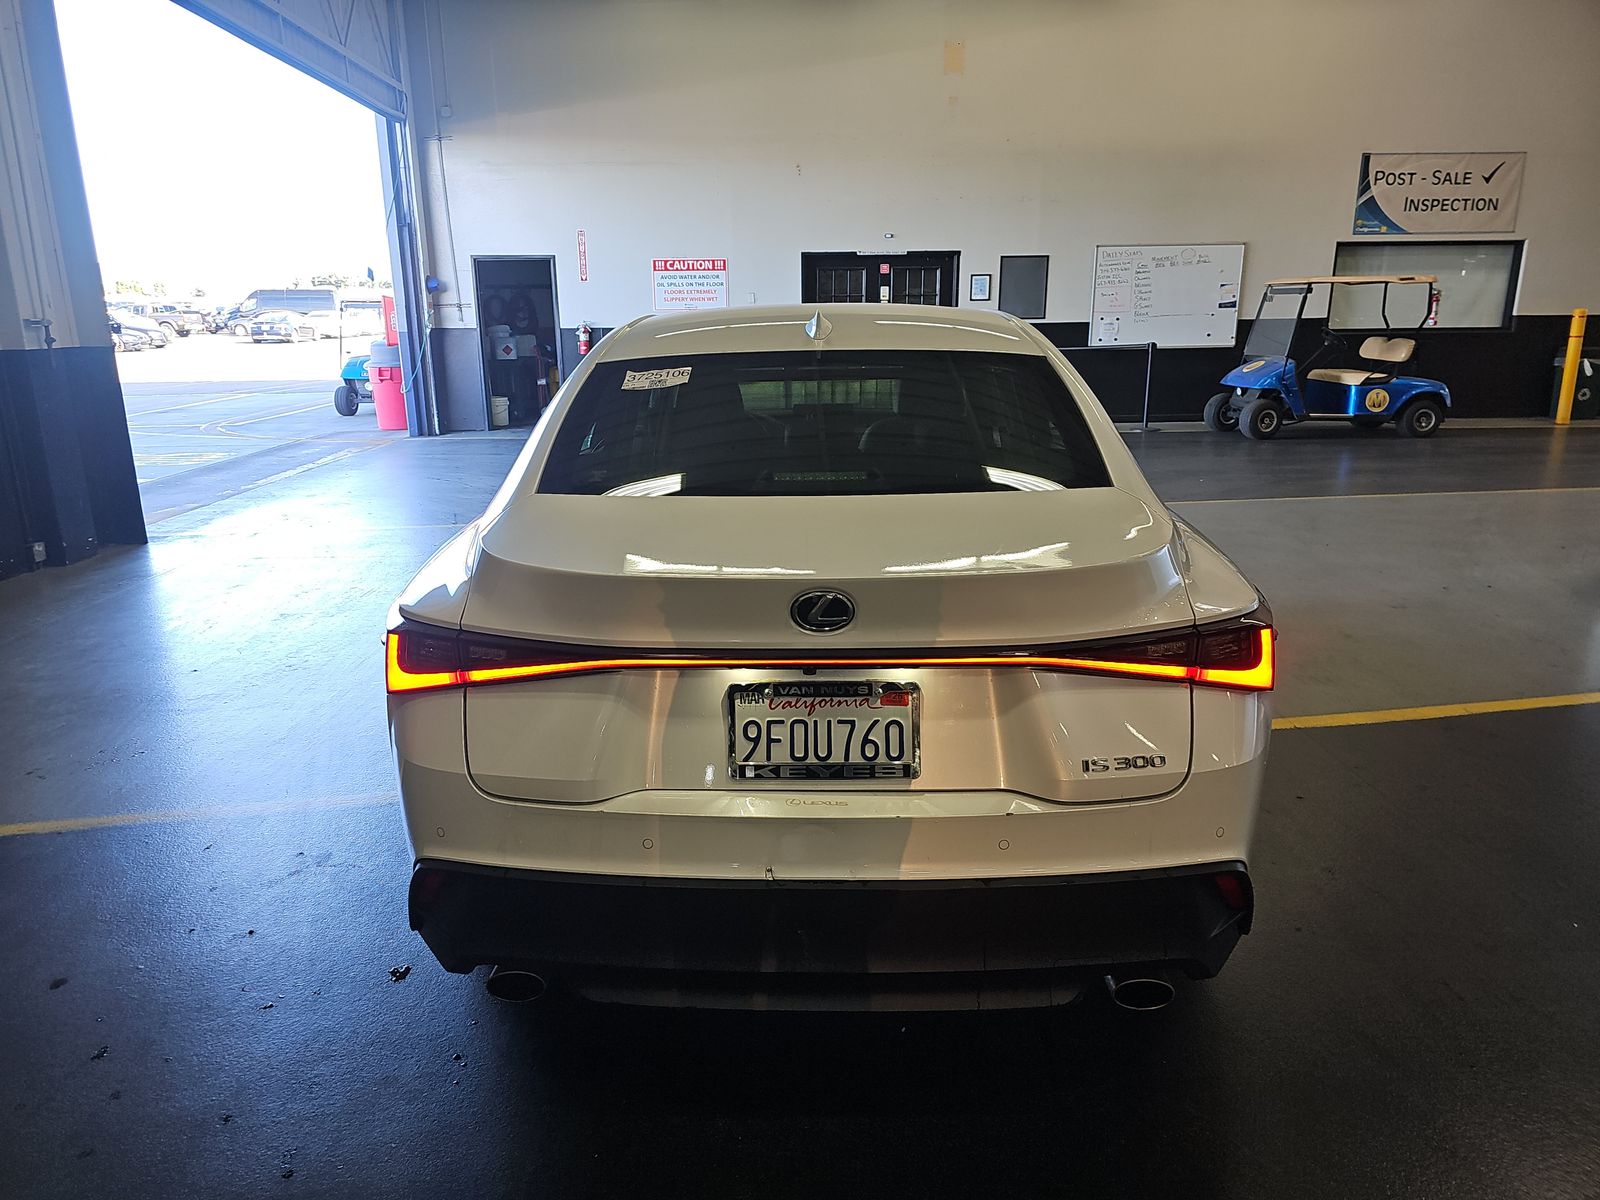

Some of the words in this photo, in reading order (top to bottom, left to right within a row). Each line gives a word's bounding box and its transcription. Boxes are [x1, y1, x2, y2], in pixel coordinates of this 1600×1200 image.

[1373, 170, 1417, 186] POST
[1431, 169, 1473, 185] SALE
[1403, 196, 1499, 212] INSPECTION
[666, 260, 713, 270] CAUTION
[626, 370, 690, 382] 3725106
[779, 685, 815, 695] VAN
[820, 685, 870, 695] NUYS
[768, 696, 883, 717] California
[742, 718, 905, 763] 9FOU760
[745, 765, 904, 778] KEYES
[1081, 757, 1110, 773] IS
[1113, 754, 1167, 771] 300
